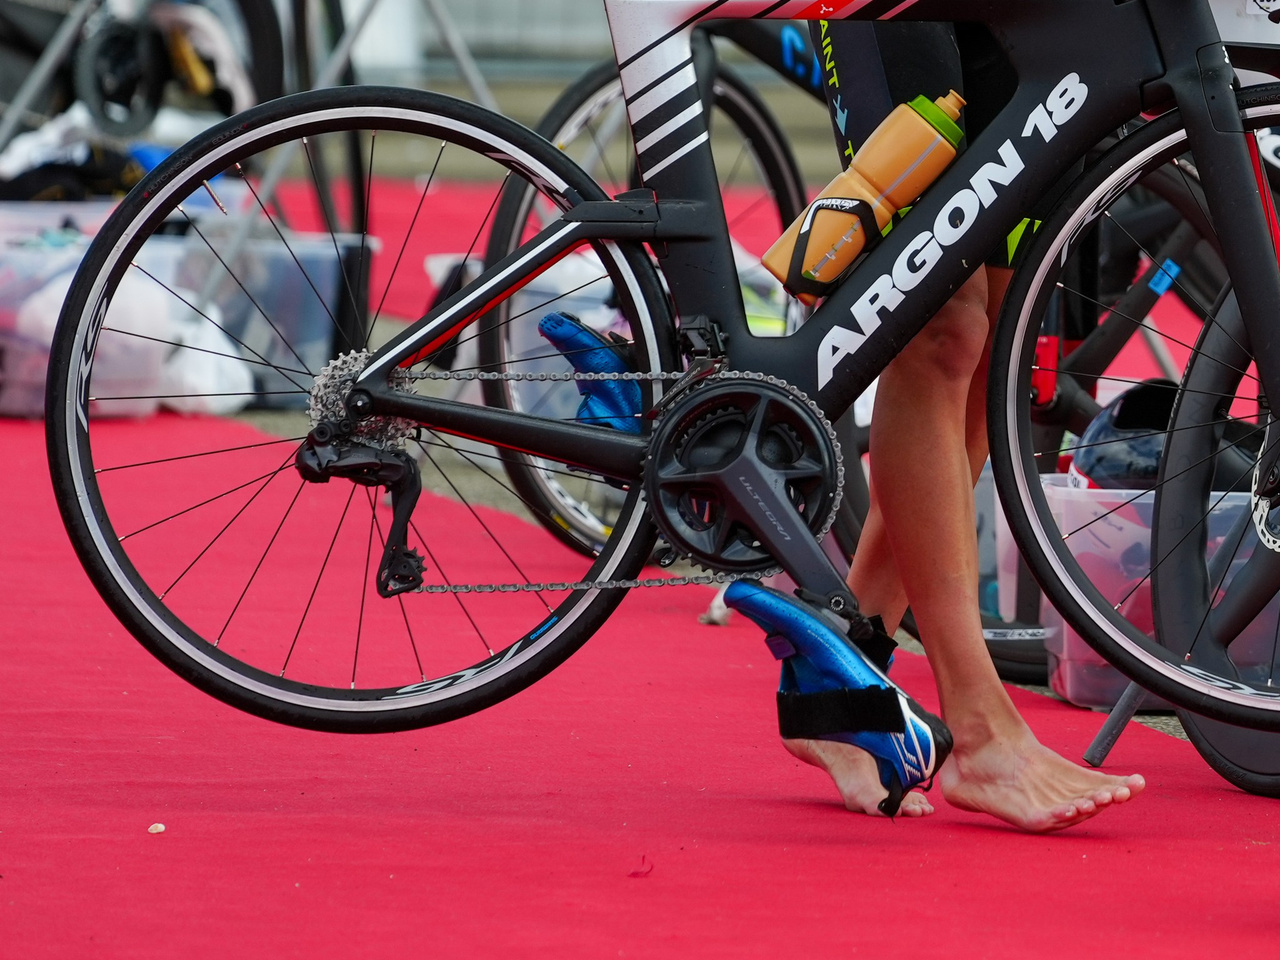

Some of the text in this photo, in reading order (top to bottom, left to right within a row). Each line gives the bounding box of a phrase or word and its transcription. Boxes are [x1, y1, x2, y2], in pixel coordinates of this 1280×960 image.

[819, 19, 840, 89] AINT
[817, 71, 1089, 392] ARGON 18
[738, 475, 792, 541] ULTEGRA
